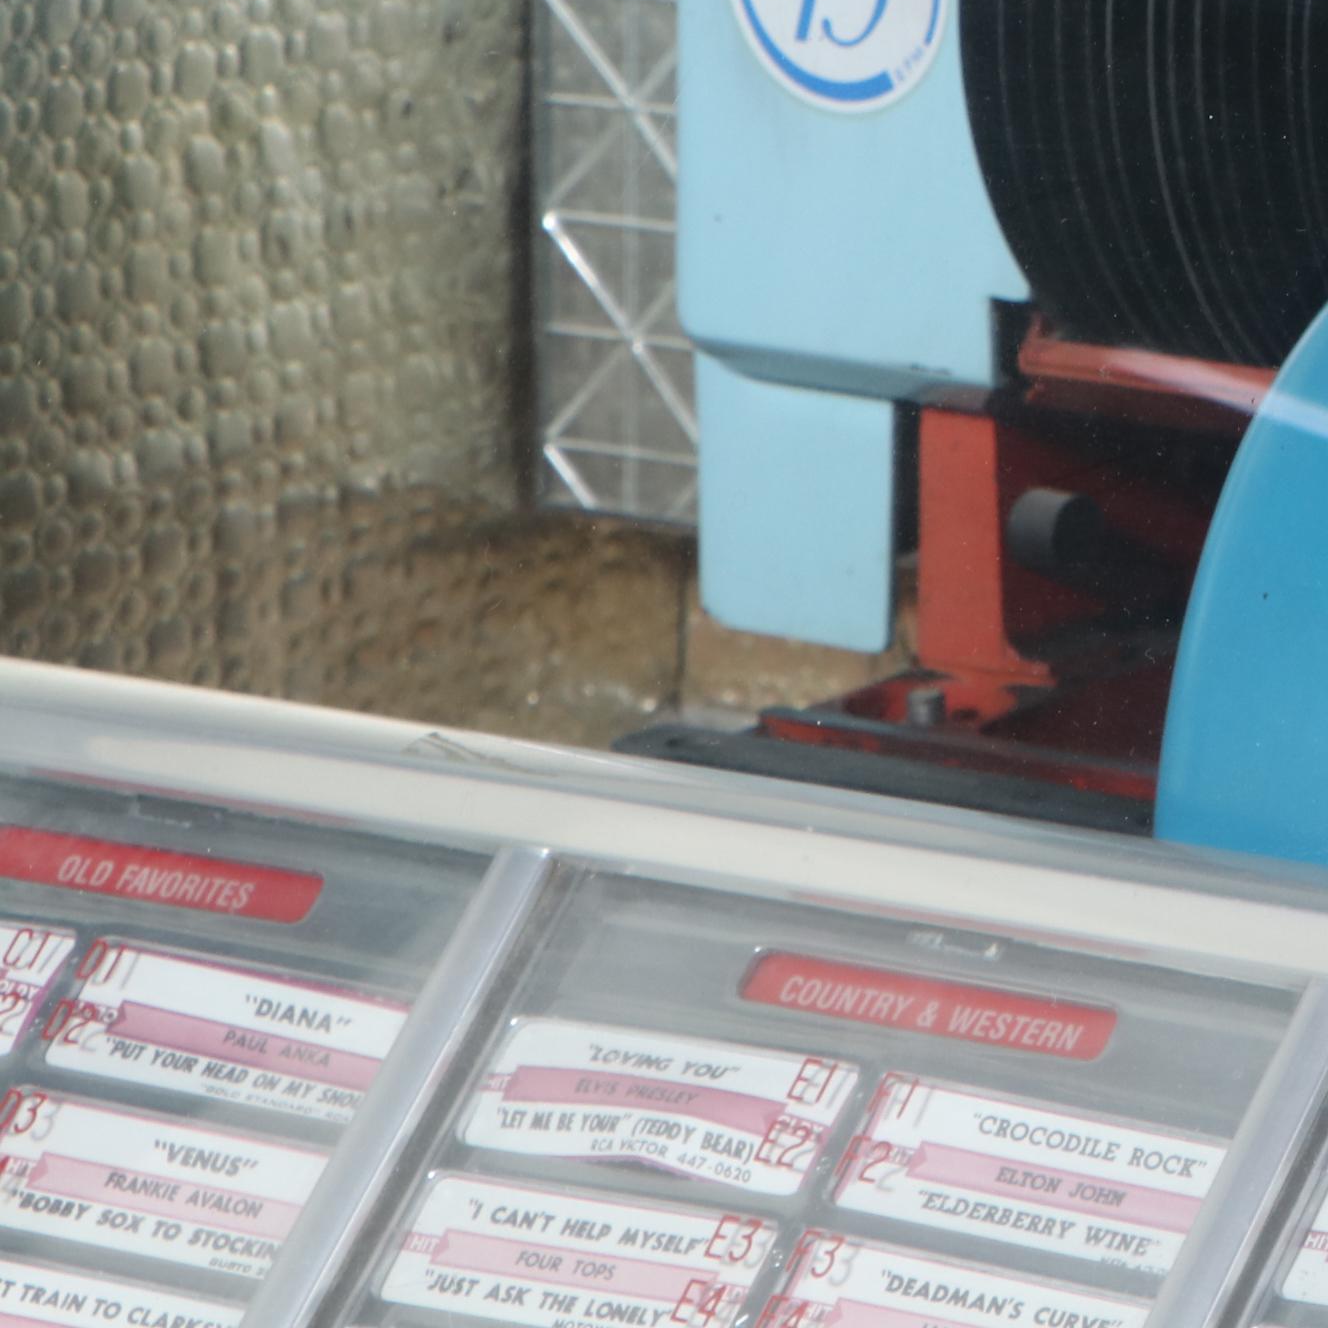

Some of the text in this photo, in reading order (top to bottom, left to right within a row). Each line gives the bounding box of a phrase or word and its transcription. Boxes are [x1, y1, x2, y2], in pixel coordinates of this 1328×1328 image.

[57, 855, 255, 910] OLD FAVORITES
[245, 993, 352, 1033] "DIANA"
[779, 975, 1084, 1050] COUNTRY & WESTERN
[223, 1030, 332, 1068] PAUL ANKA
[151, 1050, 199, 1074] YOUR
[253, 1074, 281, 1090] ON
[283, 1081, 318, 1100] MY
[575, 1078, 698, 1105] ELVIS PRESLEY
[787, 1057, 838, 1102] E1
[529, 1111, 553, 1131] ME
[556, 1112, 575, 1132] BE
[153, 1139, 259, 1177] "VENUS"
[619, 1139, 669, 1158] VICTOR
[973, 1113, 1207, 1178] "CROCODILE ROCK"
[104, 1172, 264, 1219] FRANKIE AVALON
[995, 1166, 1128, 1208] ELTON JOHN
[96, 1210, 147, 1234] SOX
[150, 1221, 183, 1242] TO
[490, 1206, 555, 1232] CAN'T
[560, 1218, 611, 1242] HELP
[515, 1249, 616, 1281] FOUR TOPS
[20, 1284, 87, 1314] TRAIN
[91, 1299, 122, 1319] TO
[483, 1283, 531, 1306] ASK
[538, 1291, 578, 1314] THE
